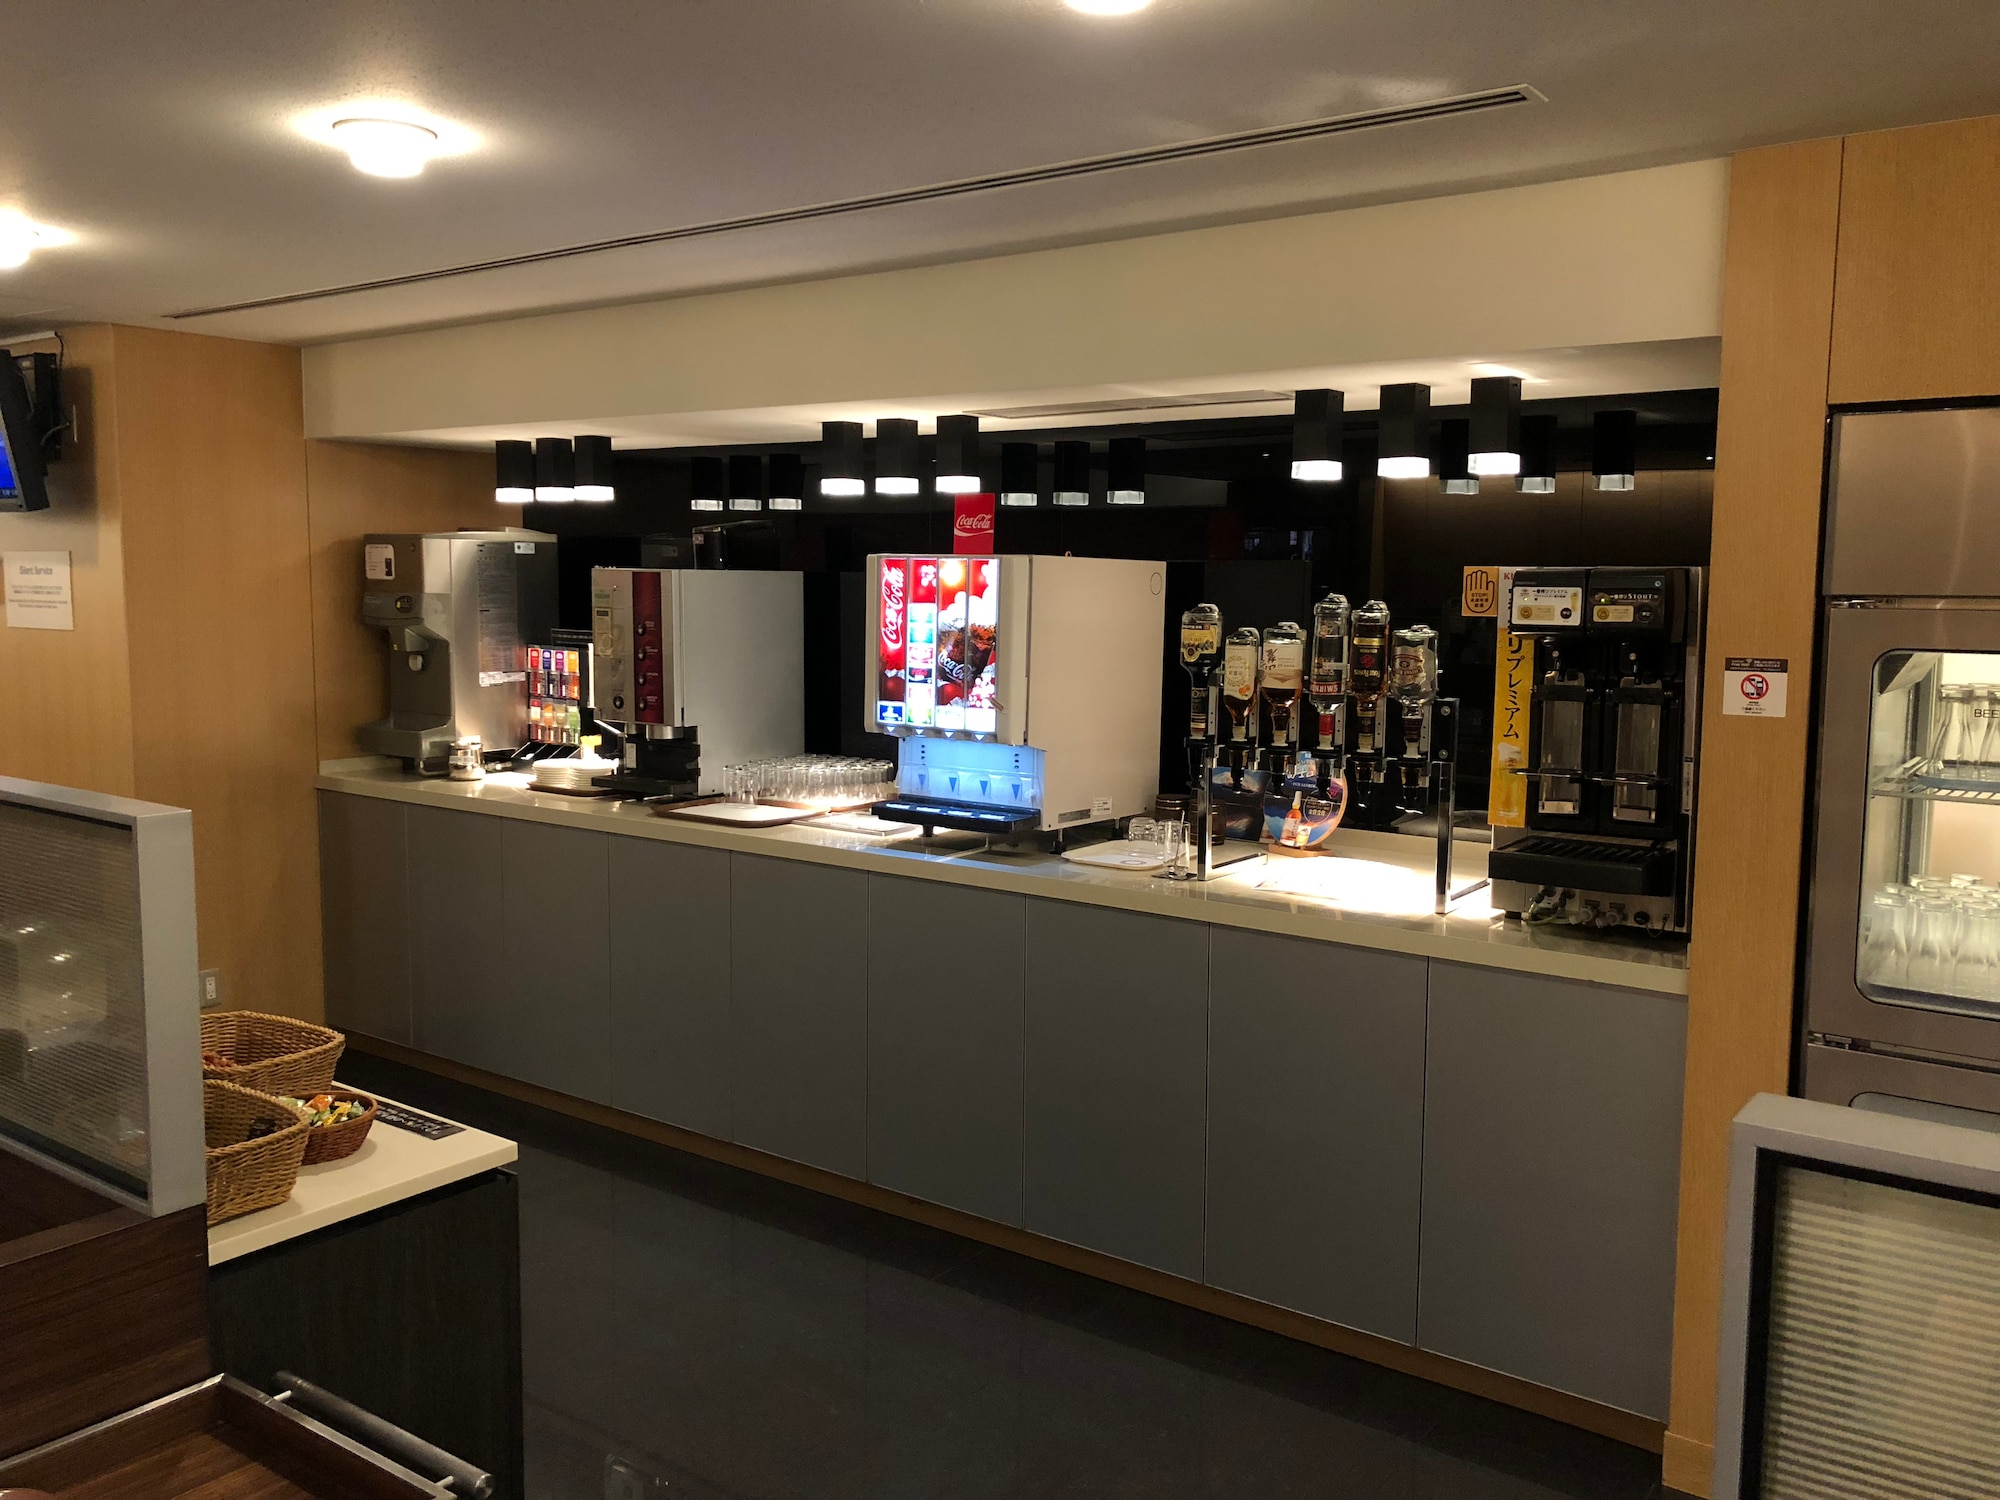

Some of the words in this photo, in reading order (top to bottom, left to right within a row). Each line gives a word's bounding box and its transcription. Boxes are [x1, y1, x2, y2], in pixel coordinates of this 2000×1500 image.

[956, 514, 992, 529] Coca-Cola
[881, 562, 904, 650] Coca-Cola
[1503, 588, 1525, 739] りプレミアム
